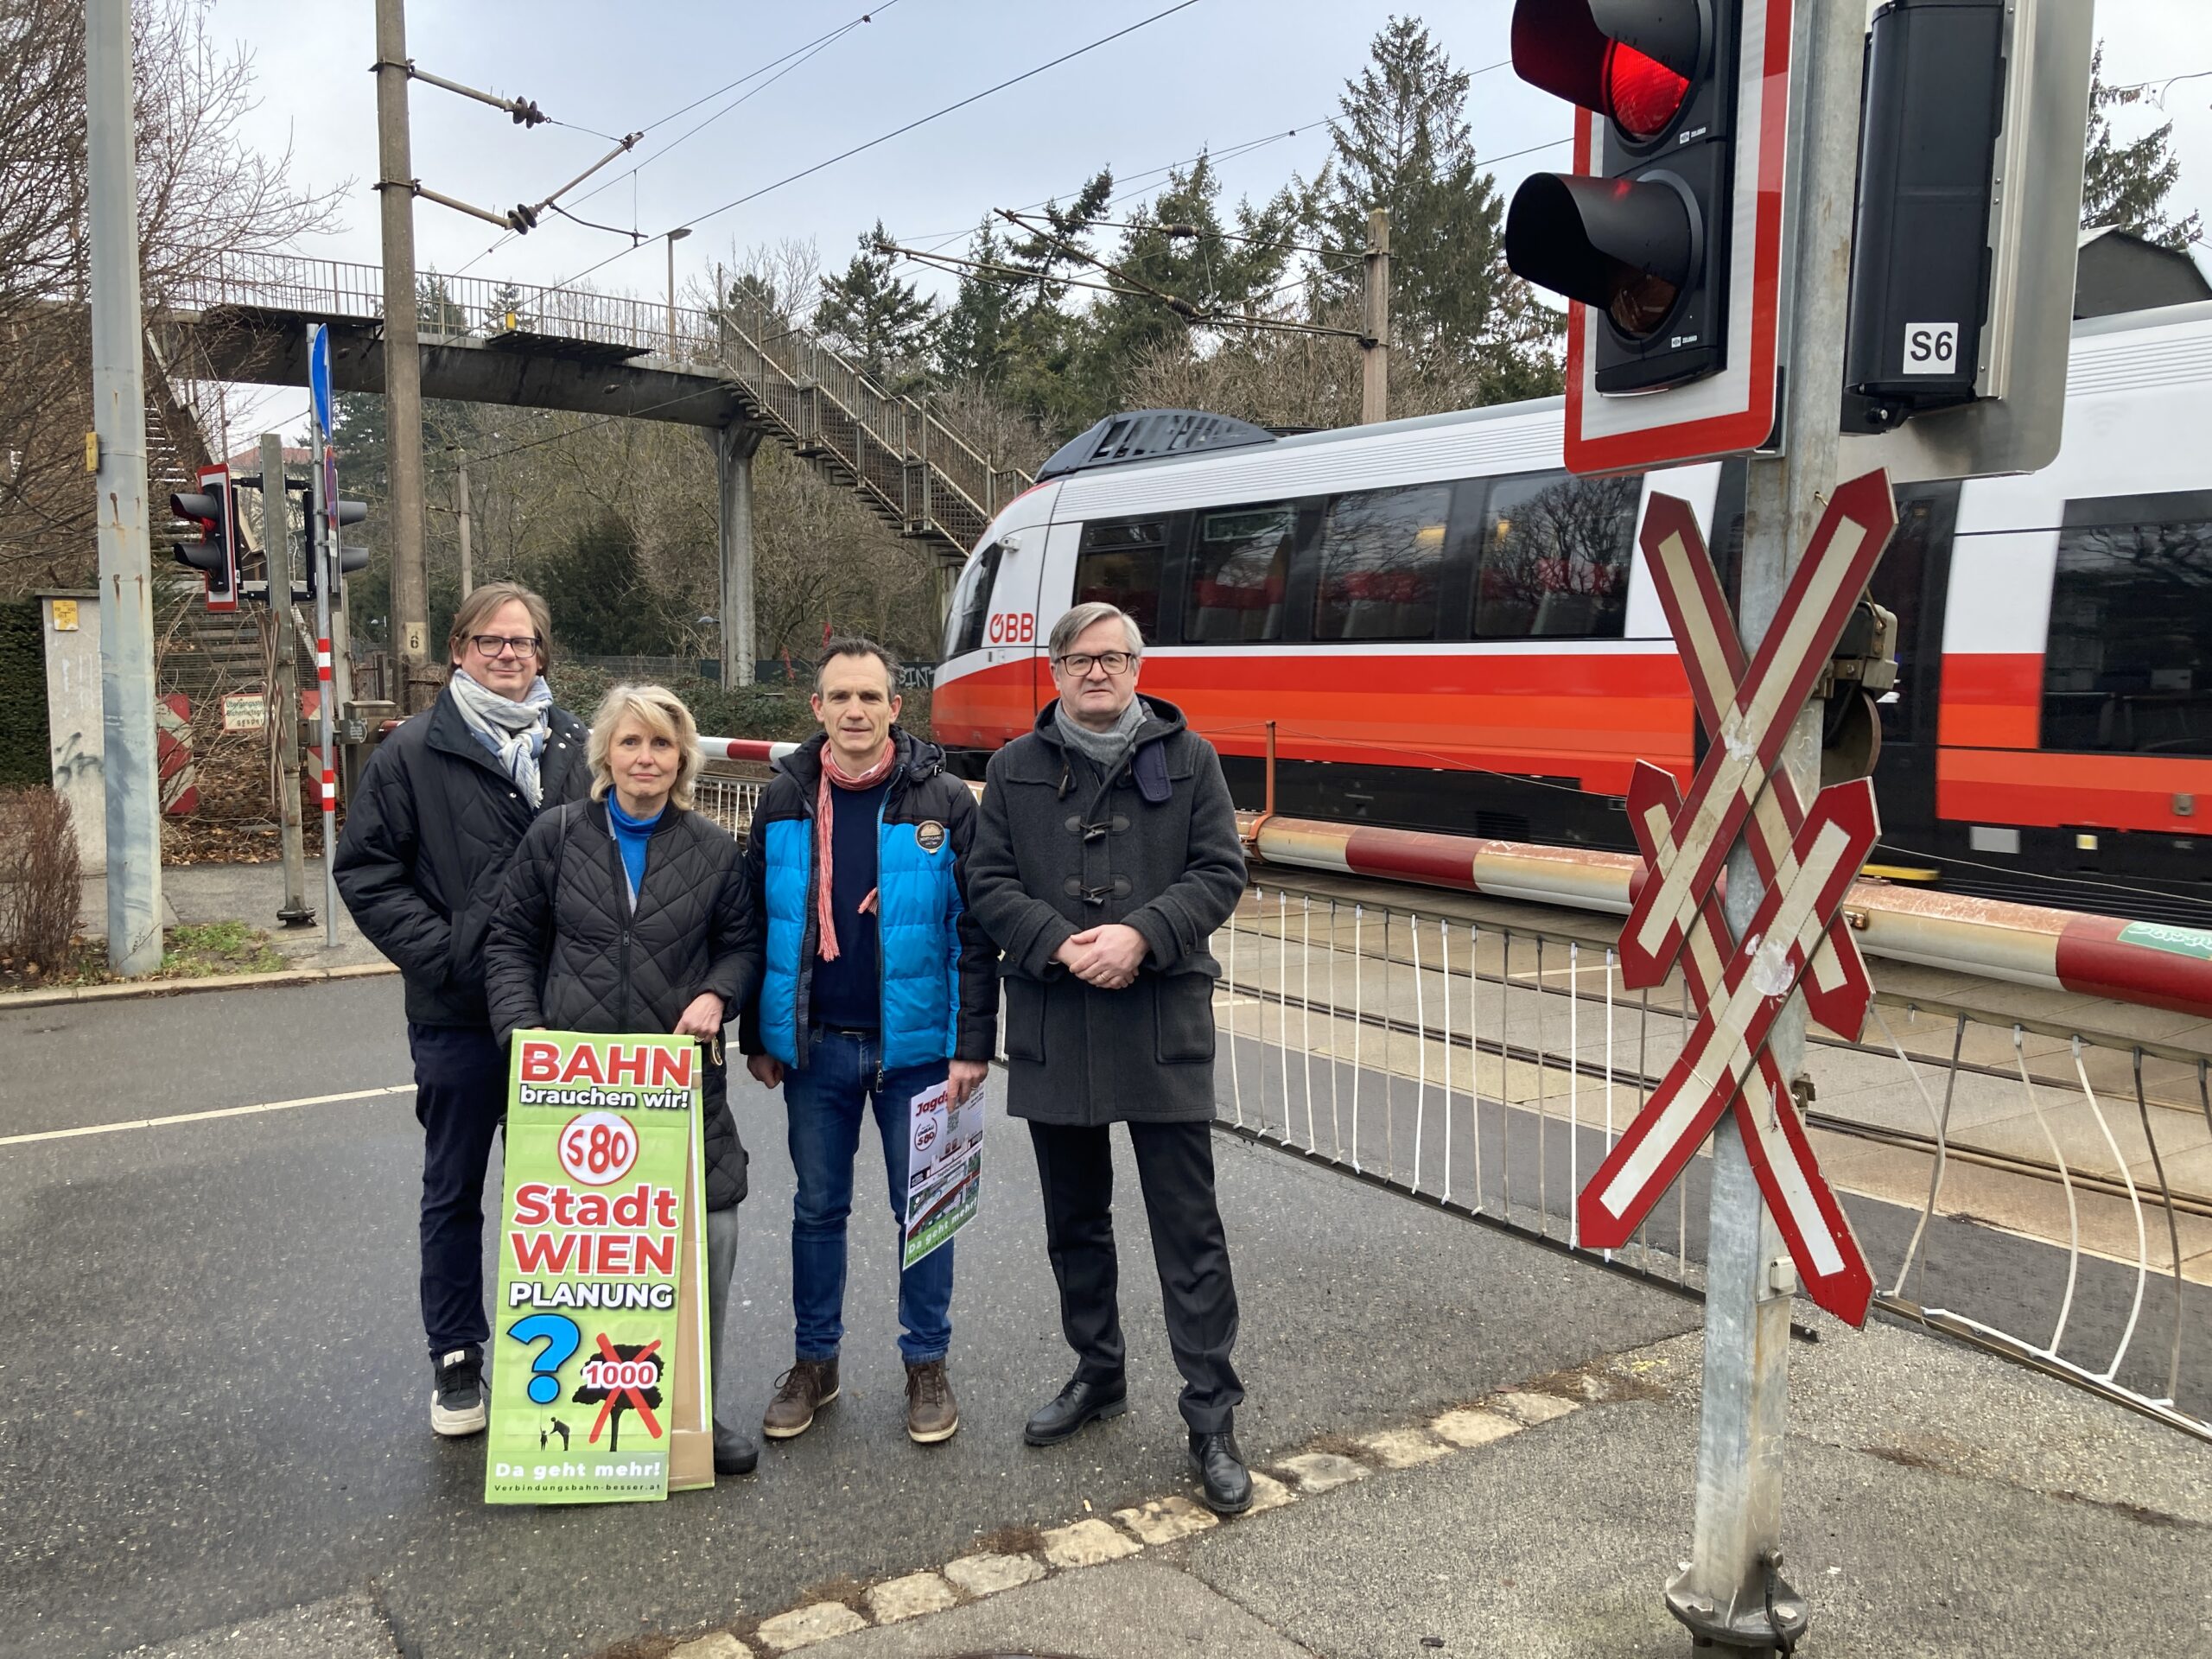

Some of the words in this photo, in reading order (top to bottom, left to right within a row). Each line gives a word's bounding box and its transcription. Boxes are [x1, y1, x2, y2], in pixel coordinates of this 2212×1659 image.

[1910, 330, 1953, 361] S6
[989, 613, 1034, 644] ÖBB
[519, 1040, 693, 1089] BAHN
[520, 1085, 637, 1108] brauchen
[642, 1090, 690, 1109] wir!
[915, 1090, 948, 1117] Jagds
[567, 1123, 629, 1174] S80
[513, 1183, 680, 1229] Stadt
[509, 1230, 680, 1277] WIEN
[908, 1239, 923, 1255] Da
[925, 1221, 949, 1246] geht
[509, 1282, 674, 1309] PLANUNG
[584, 1362, 657, 1389] 1000
[495, 1462, 524, 1478] Da
[533, 1462, 587, 1481] geht
[594, 1461, 660, 1478] mehr!
[494, 1483, 661, 1493] Verbindungsbahn-besser.at
